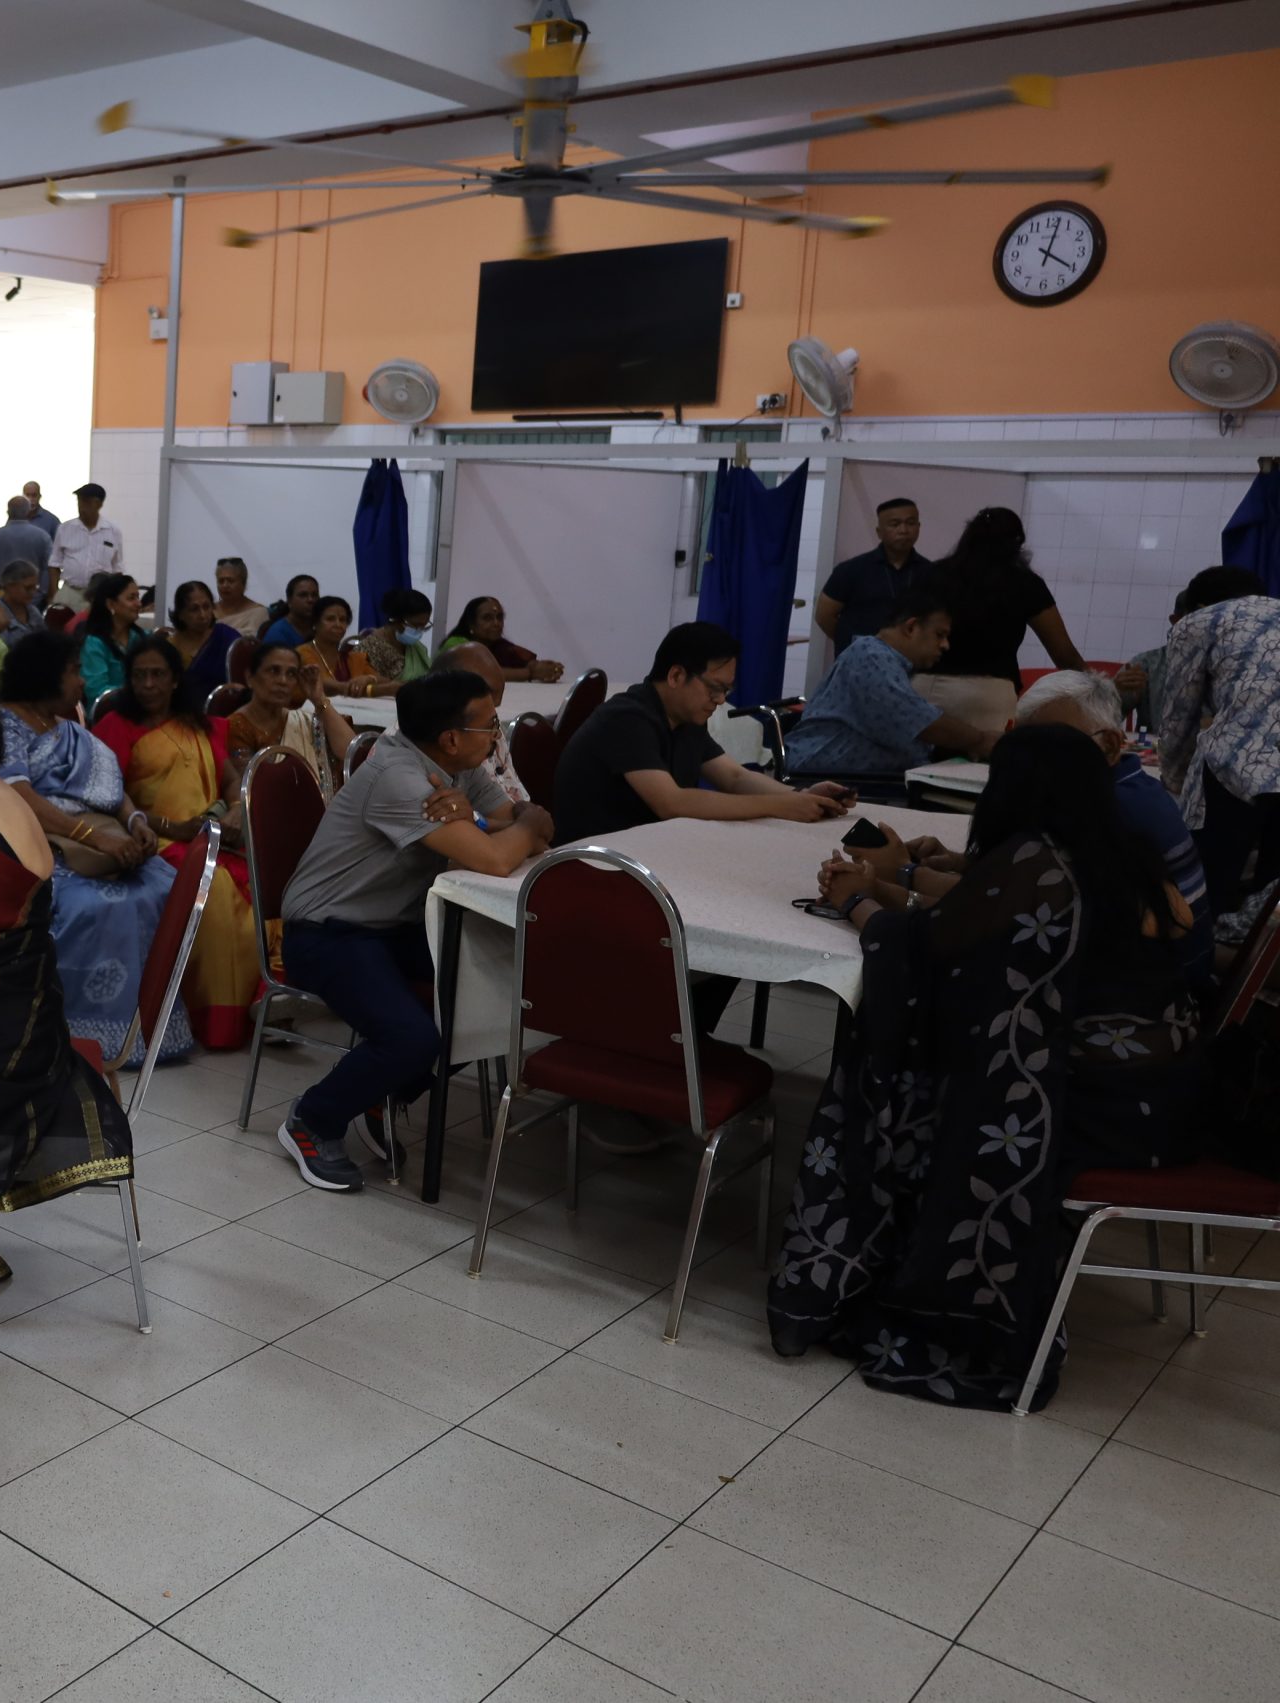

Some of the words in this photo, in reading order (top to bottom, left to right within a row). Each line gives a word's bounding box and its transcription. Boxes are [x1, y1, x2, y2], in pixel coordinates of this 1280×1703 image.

[1030, 221, 1040, 233] 11
[1046, 217, 1059, 229] 12
[1066, 219, 1071, 231] 1
[1017, 234, 1029, 246] 10
[1075, 230, 1084, 242] 2
[1011, 250, 1020, 262] 9
[1077, 245, 1086, 258] 3
[1013, 265, 1022, 277] 8
[1069, 262, 1077, 273] 4
[1024, 276, 1032, 288] 7
[1039, 279, 1048, 290] 6
[1057, 274, 1065, 286] 5
